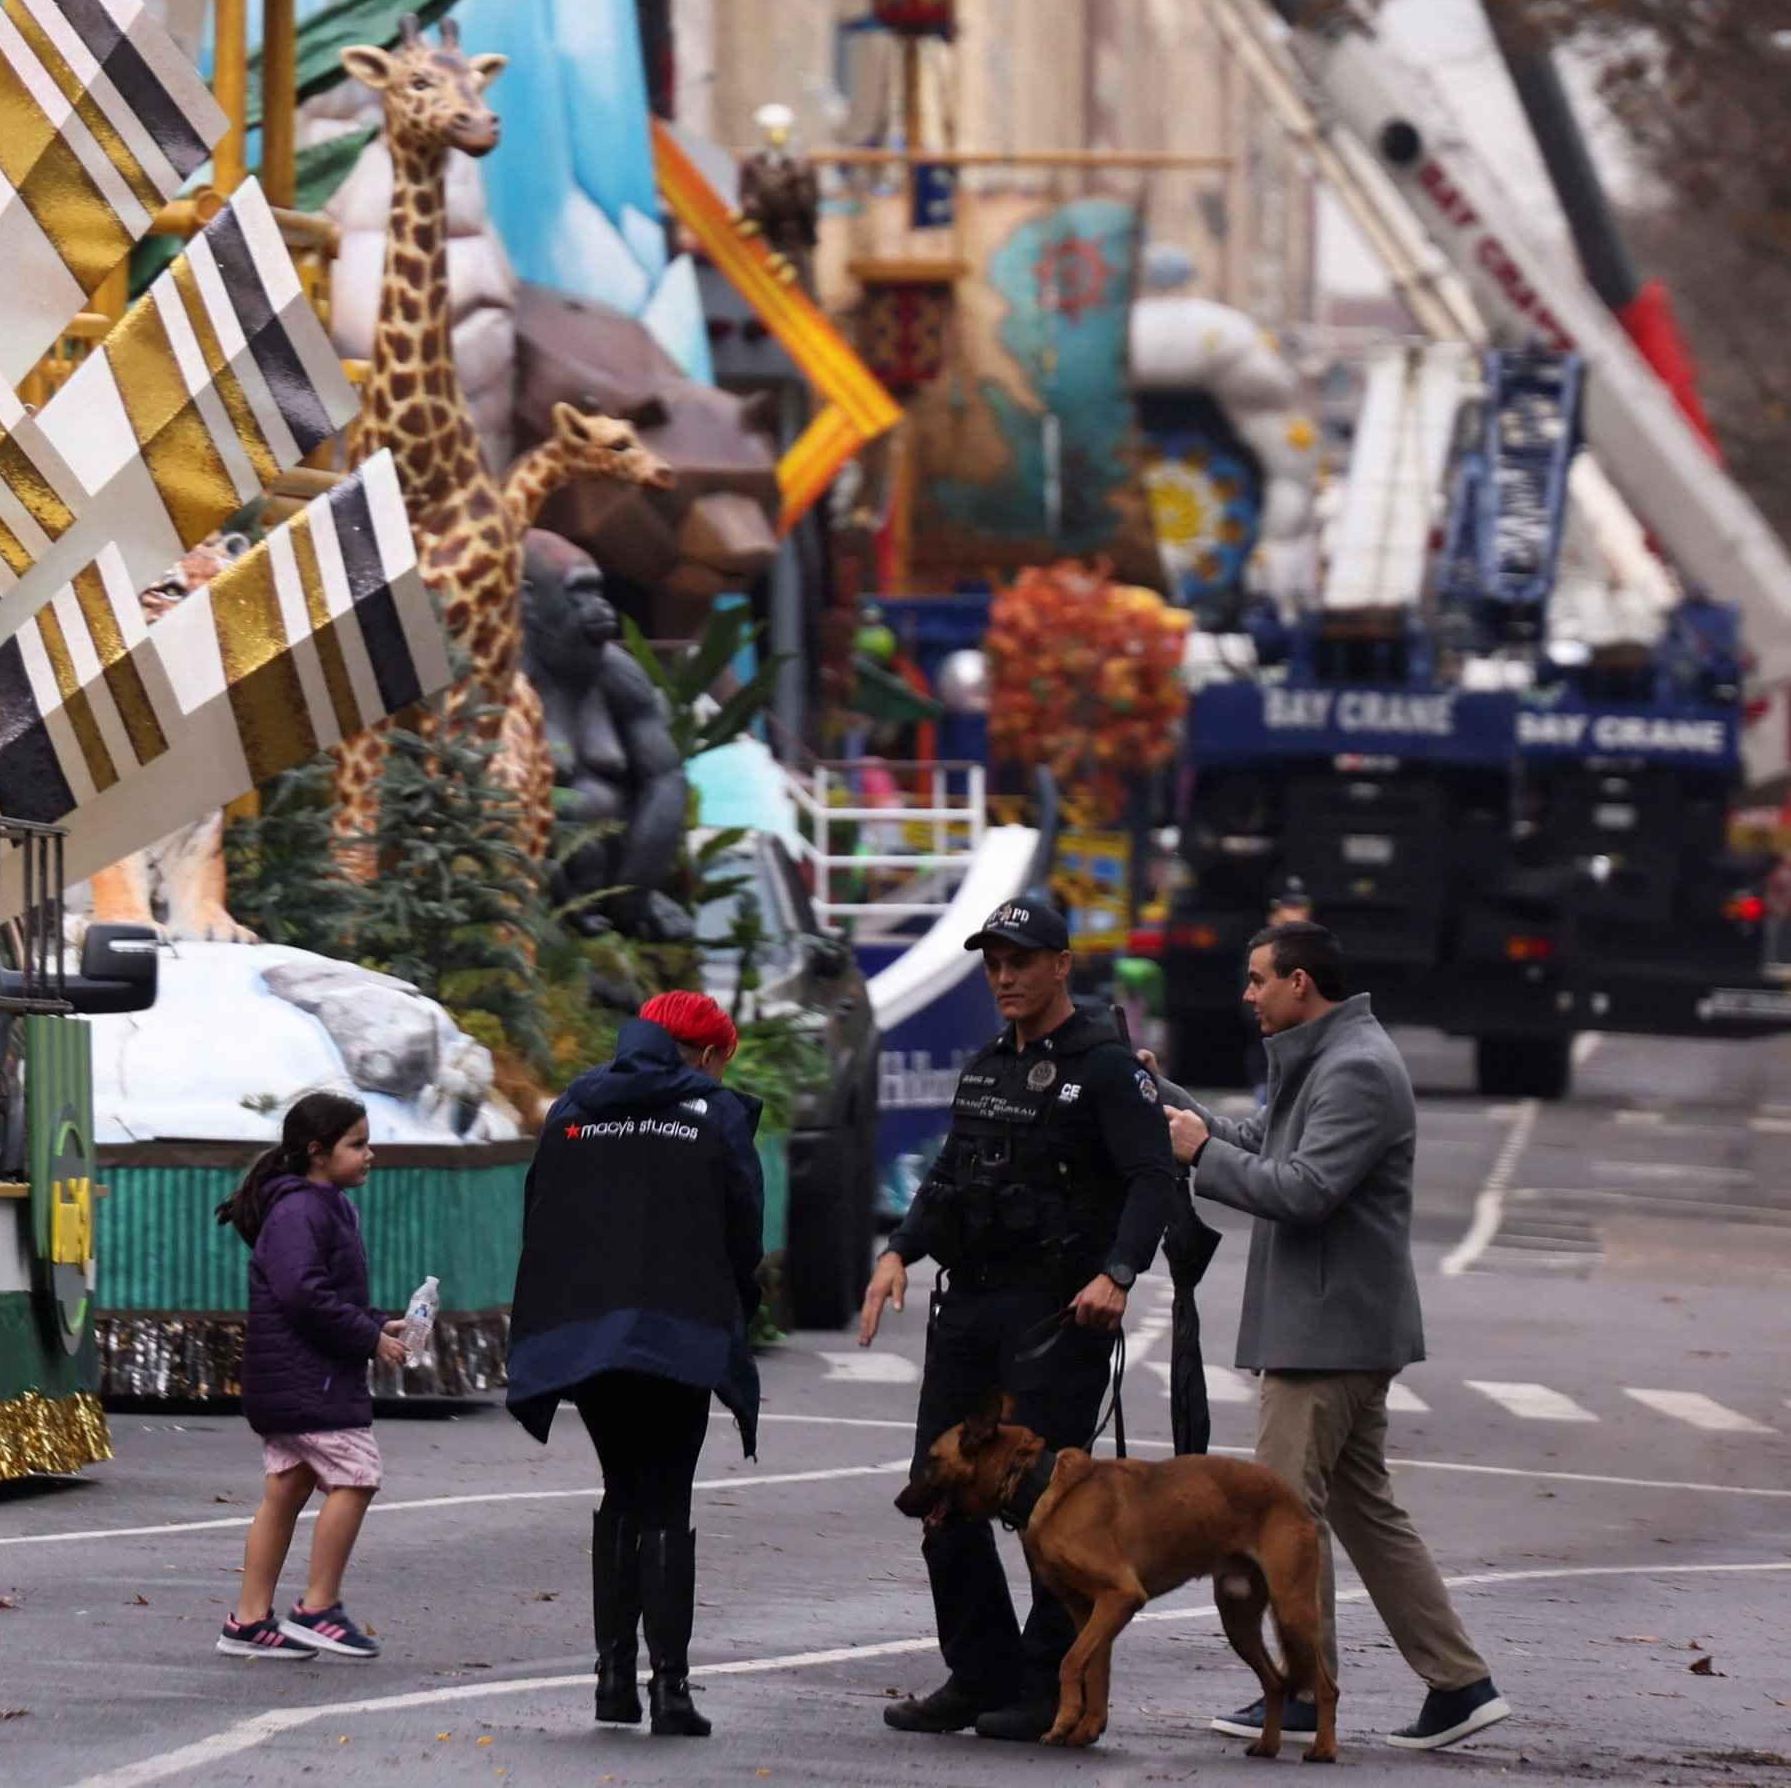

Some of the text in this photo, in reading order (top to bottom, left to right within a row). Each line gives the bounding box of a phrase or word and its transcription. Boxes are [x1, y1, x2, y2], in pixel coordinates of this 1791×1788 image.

[1263, 687, 1453, 734] BAY CRANE
[1519, 711, 1725, 752] BAY CRANE
[581, 1115, 699, 1140] macy's studios
